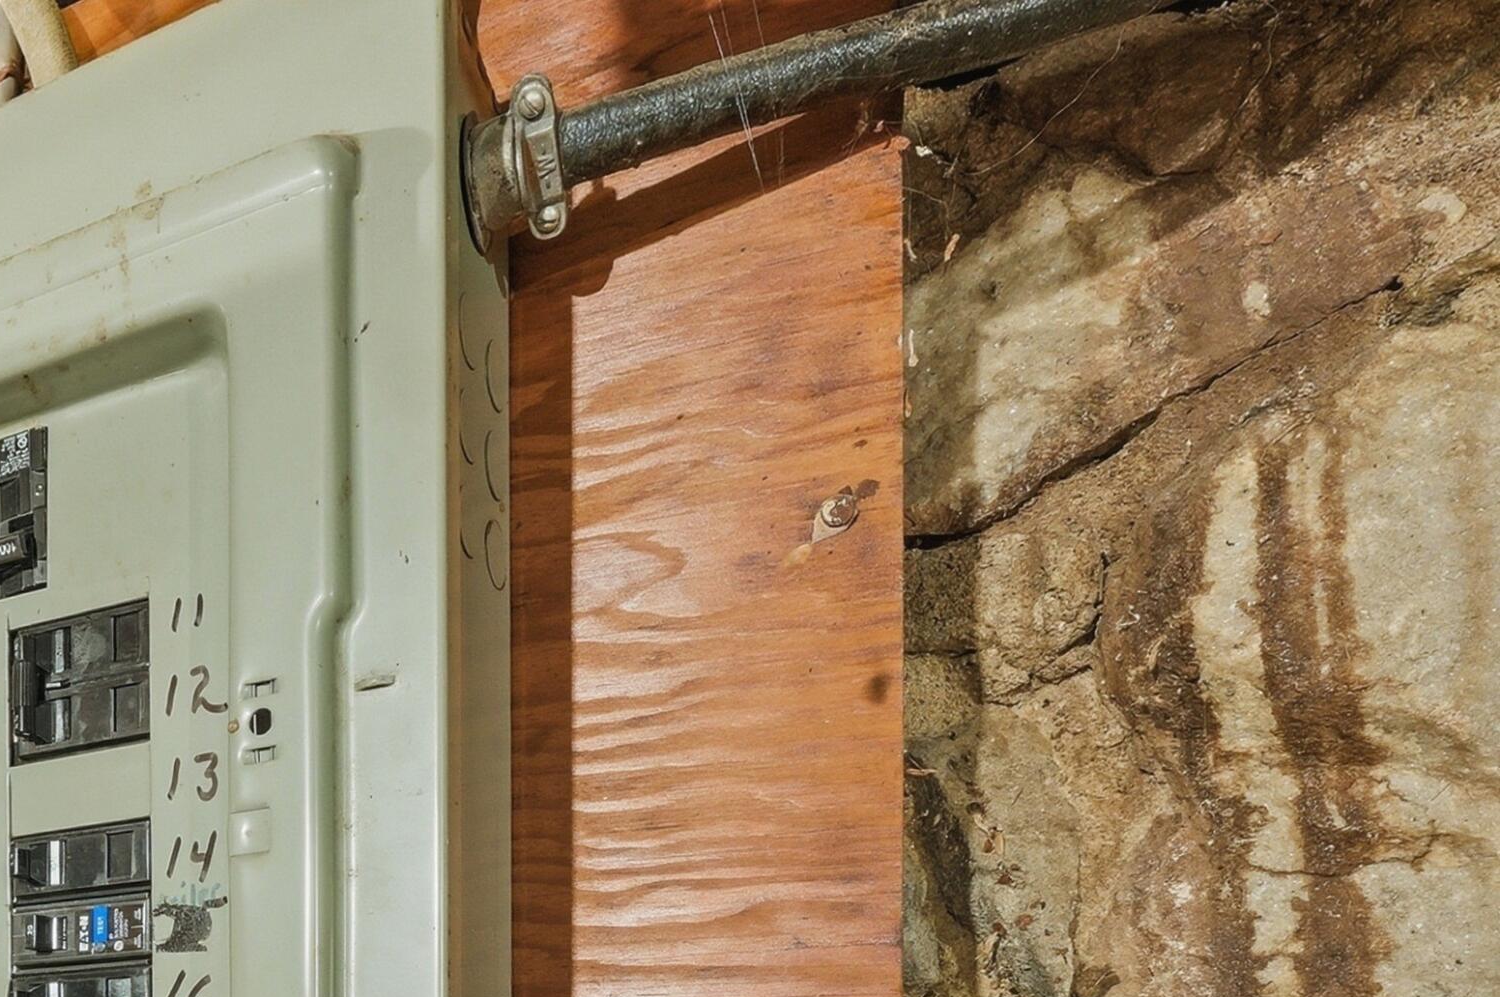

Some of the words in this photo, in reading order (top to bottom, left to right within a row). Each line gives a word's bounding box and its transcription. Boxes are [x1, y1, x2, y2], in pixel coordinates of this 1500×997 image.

[171, 593, 204, 633] 11
[165, 664, 228, 716] 12
[167, 752, 219, 801] 13
[166, 830, 218, 883] 14
